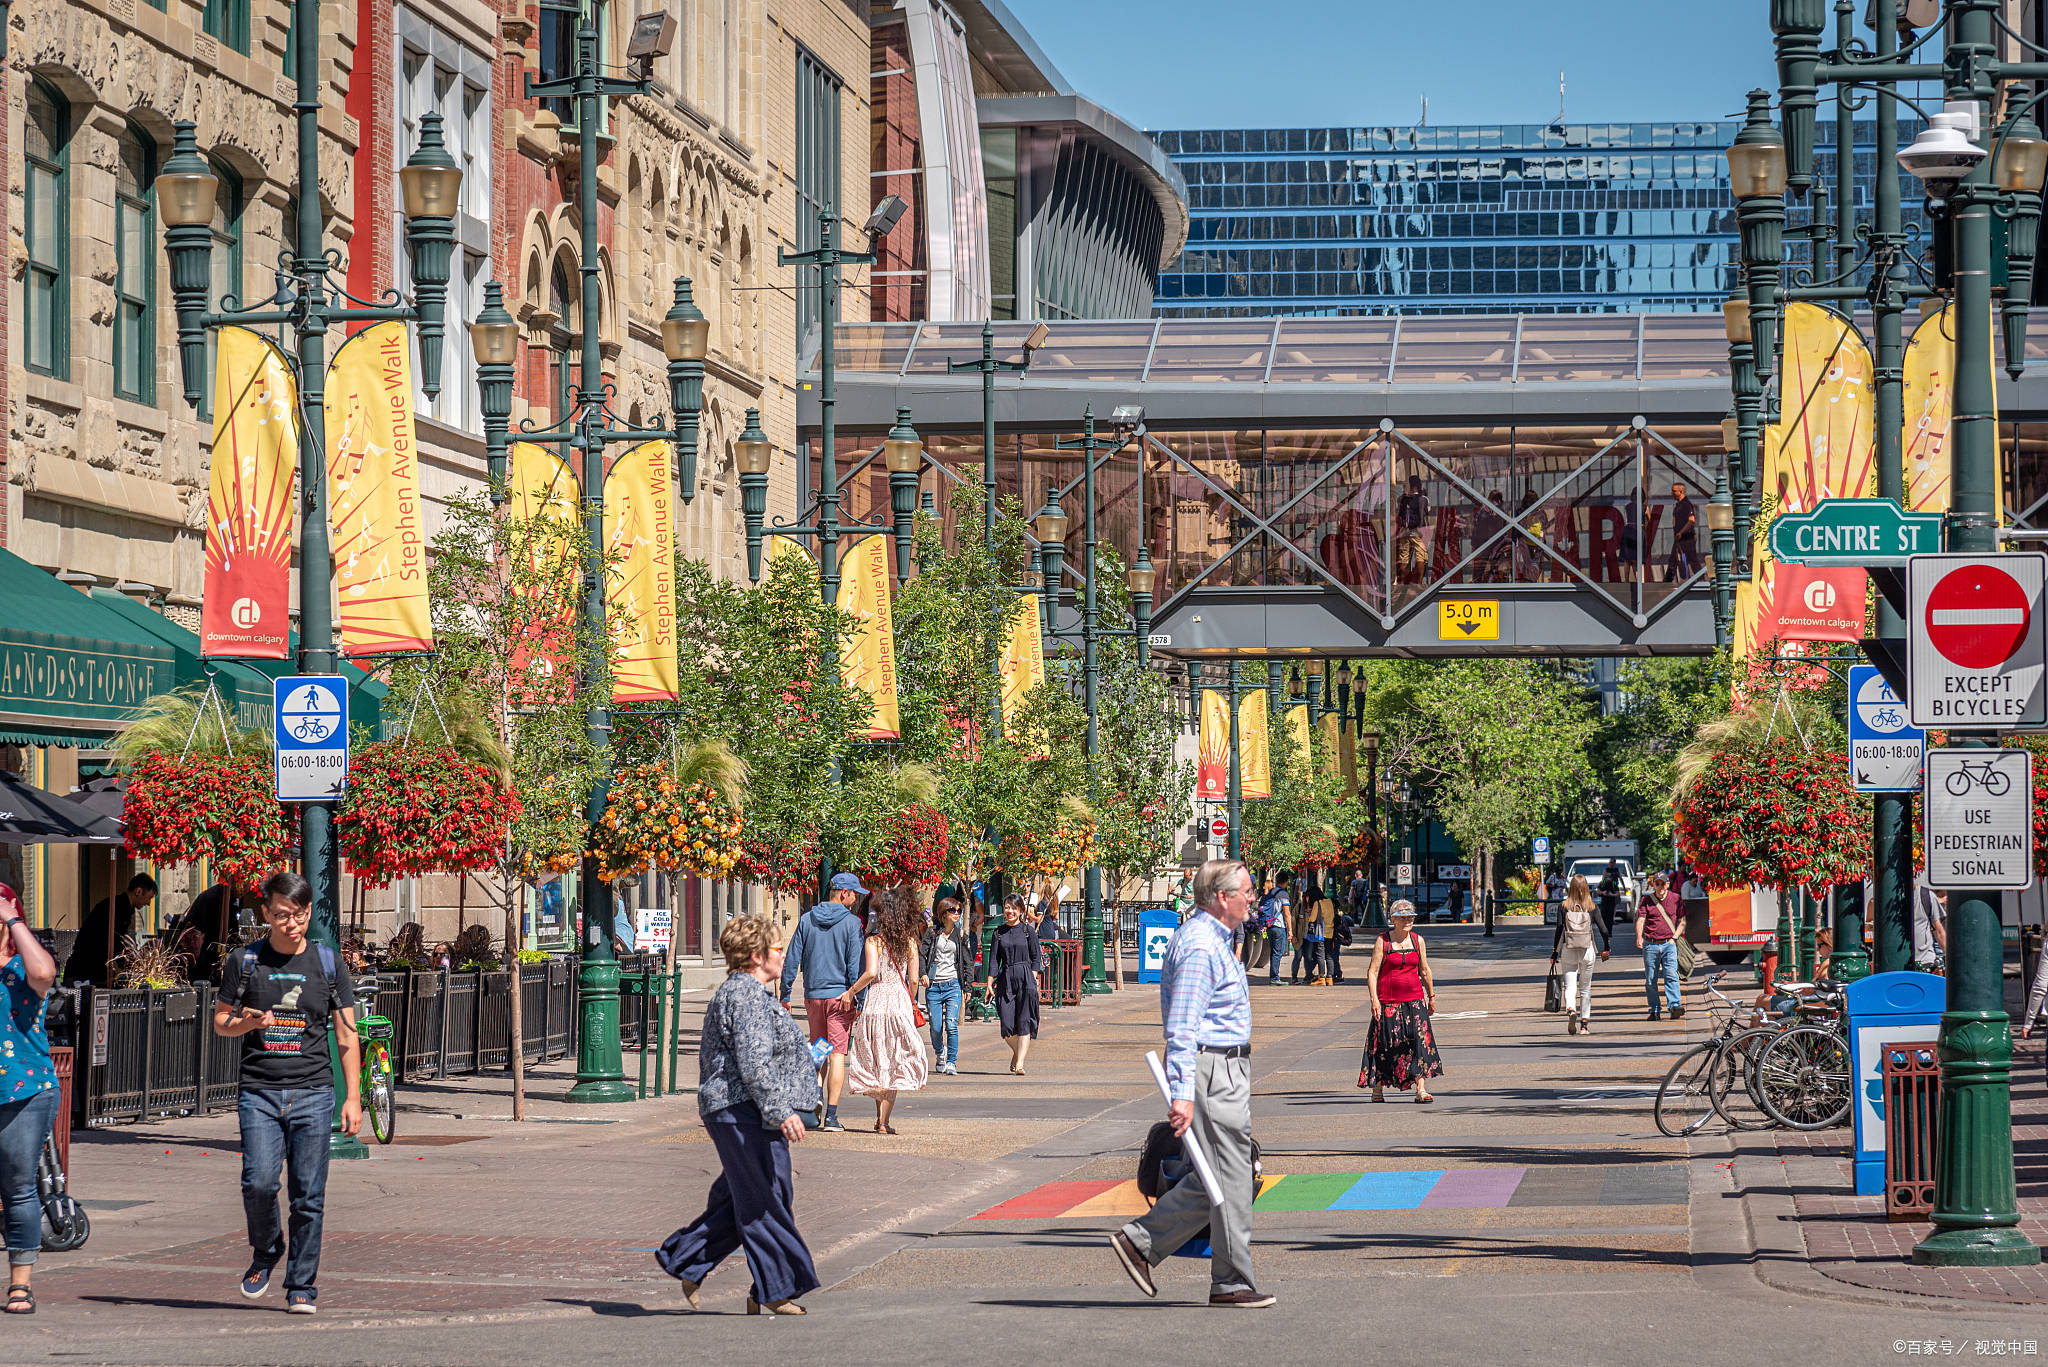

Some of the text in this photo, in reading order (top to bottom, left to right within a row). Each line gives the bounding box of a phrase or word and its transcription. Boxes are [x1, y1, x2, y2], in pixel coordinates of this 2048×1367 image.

[380, 335, 421, 581] Stephen Avenue Walk
[1795, 525, 1921, 551] CENTRE ST
[649, 451, 673, 646] Stephen Avenue Walk
[870, 543, 893, 695] Stephen Avenue Walk
[1026, 601, 1036, 630] Walk
[1446, 604, 1492, 619] 5.0 m
[1778, 616, 1859, 629] downtown calgary
[207, 631, 284, 645] downtown calgary
[1031, 631, 1041, 675] Avenue
[1945, 676, 2012, 693] EXCEPT
[1933, 699, 2026, 716] BICYCLES
[1855, 745, 1920, 759] 06:00-18:00
[281, 755, 343, 768] 06:00-18:00
[1965, 809, 1991, 824] USE
[1934, 835, 2022, 850] PEDESTRIAN
[1952, 860, 2005, 875] SIGNAL
[273, 1019, 306, 1028] EVOTED
